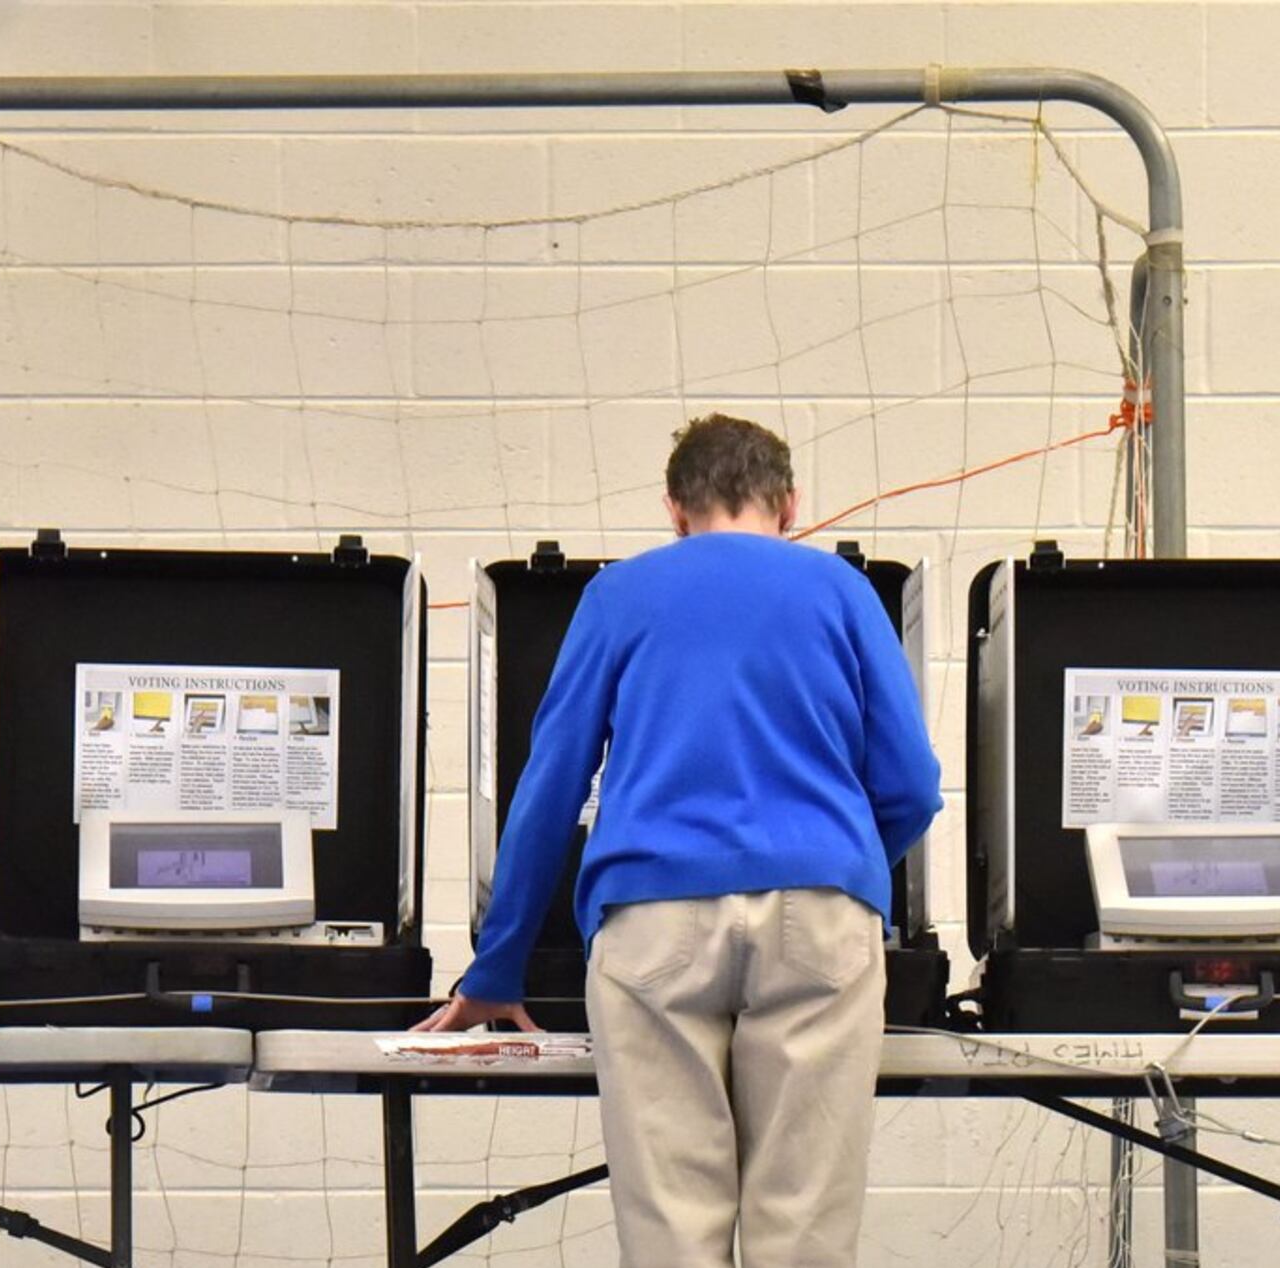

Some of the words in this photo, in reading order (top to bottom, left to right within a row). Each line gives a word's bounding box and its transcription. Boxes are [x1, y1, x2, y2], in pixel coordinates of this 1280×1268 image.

[128, 675, 181, 689] VOTING
[184, 676, 286, 691] INSTRUCTIONS
[1117, 679, 1170, 693] VOTING
[1173, 680, 1275, 694] INSTRUCTIONS
[959, 1040, 1034, 1068] PTA
